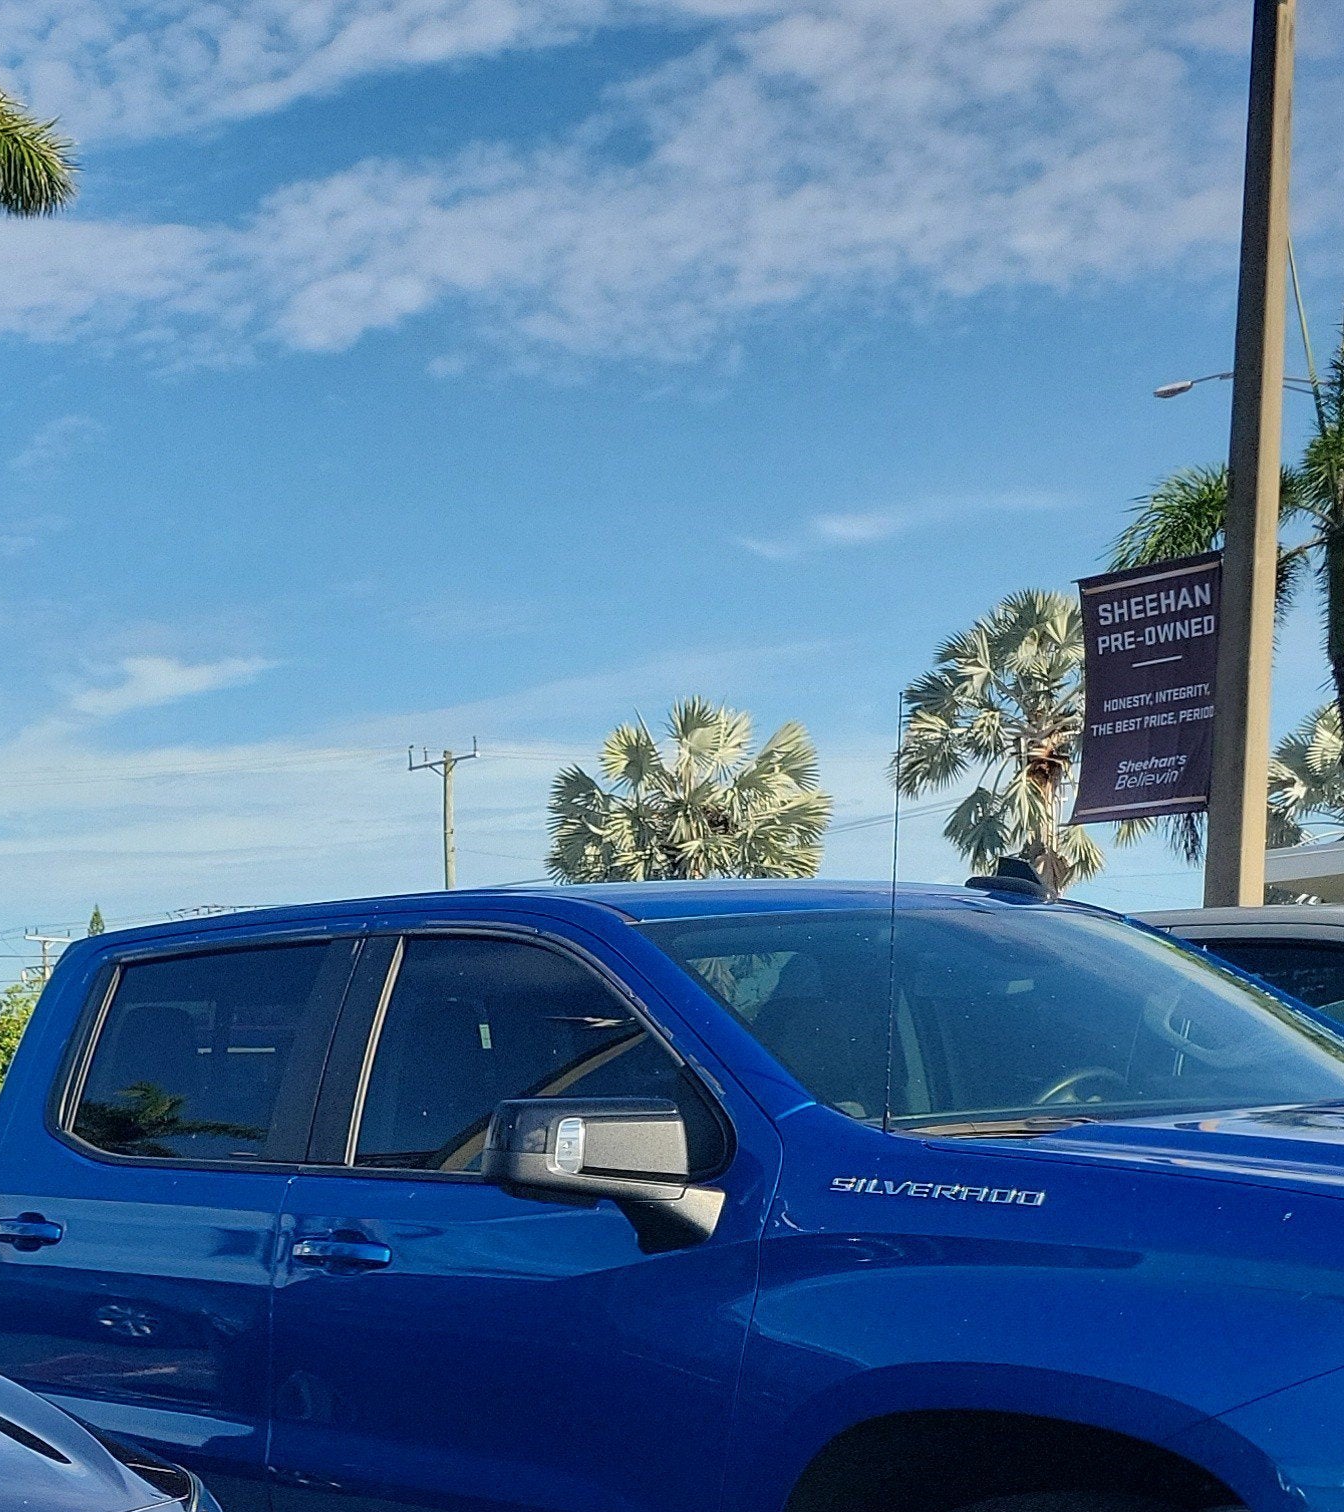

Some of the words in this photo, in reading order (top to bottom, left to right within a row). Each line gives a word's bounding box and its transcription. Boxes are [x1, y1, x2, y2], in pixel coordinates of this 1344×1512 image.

[1098, 583, 1211, 626] SHEEHAN
[1097, 615, 1215, 655] PRE-OWNED
[1103, 692, 1153, 712] HONESTY,
[1155, 683, 1211, 704] INTEGRITY,
[1091, 722, 1114, 737] THE
[1115, 717, 1143, 733] BEST
[1143, 712, 1177, 728] PRICE,
[1114, 766, 1185, 791] Believin'
[1117, 754, 1188, 774] Sheehan's
[829, 1176, 1046, 1207] SILVERADO
